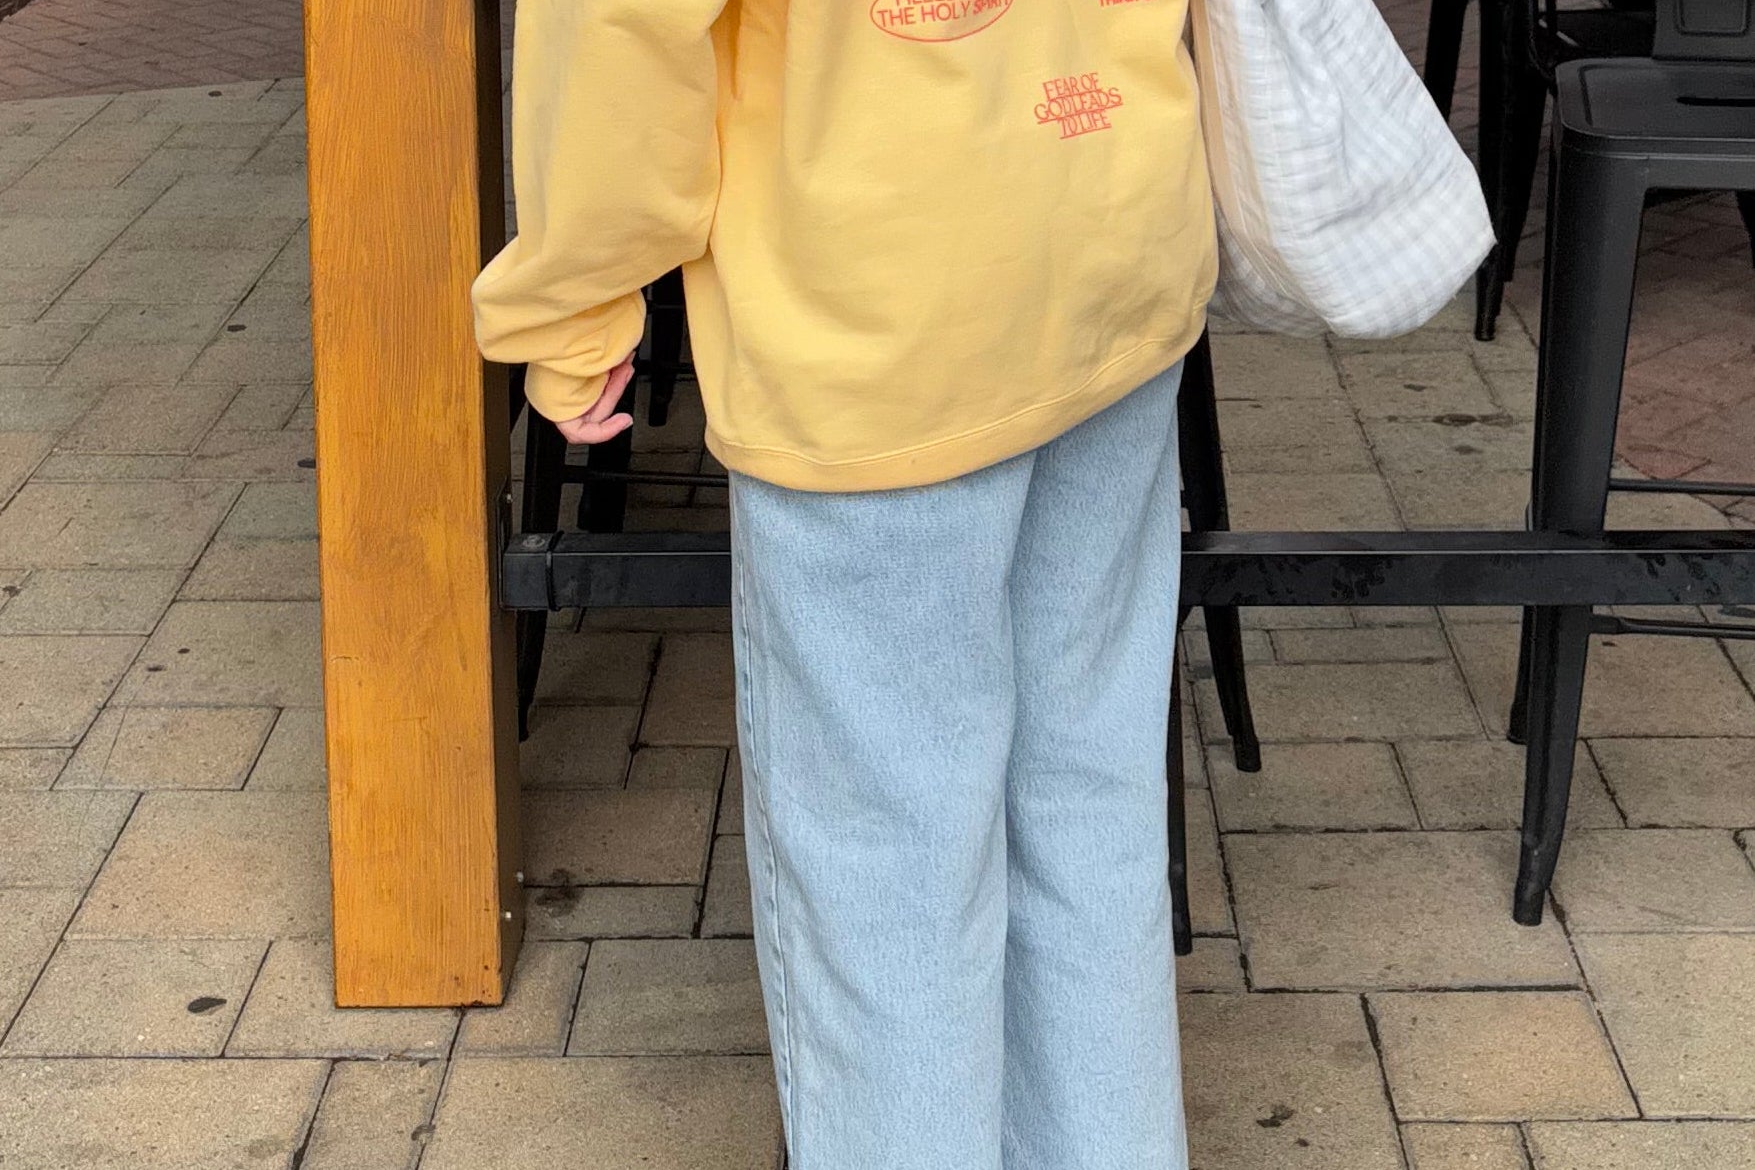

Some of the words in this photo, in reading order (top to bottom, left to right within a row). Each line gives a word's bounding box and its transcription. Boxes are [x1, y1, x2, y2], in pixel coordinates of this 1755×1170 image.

[877, 7, 916, 28] THE
[921, 1, 970, 23] HOLY
[1043, 76, 1080, 102] FEAR
[1080, 72, 1099, 91] OF
[1034, 98, 1071, 121] GOD
[1071, 87, 1122, 113] LEADS
[1058, 114, 1078, 136] TO
[1078, 110, 1112, 131] LIFE
